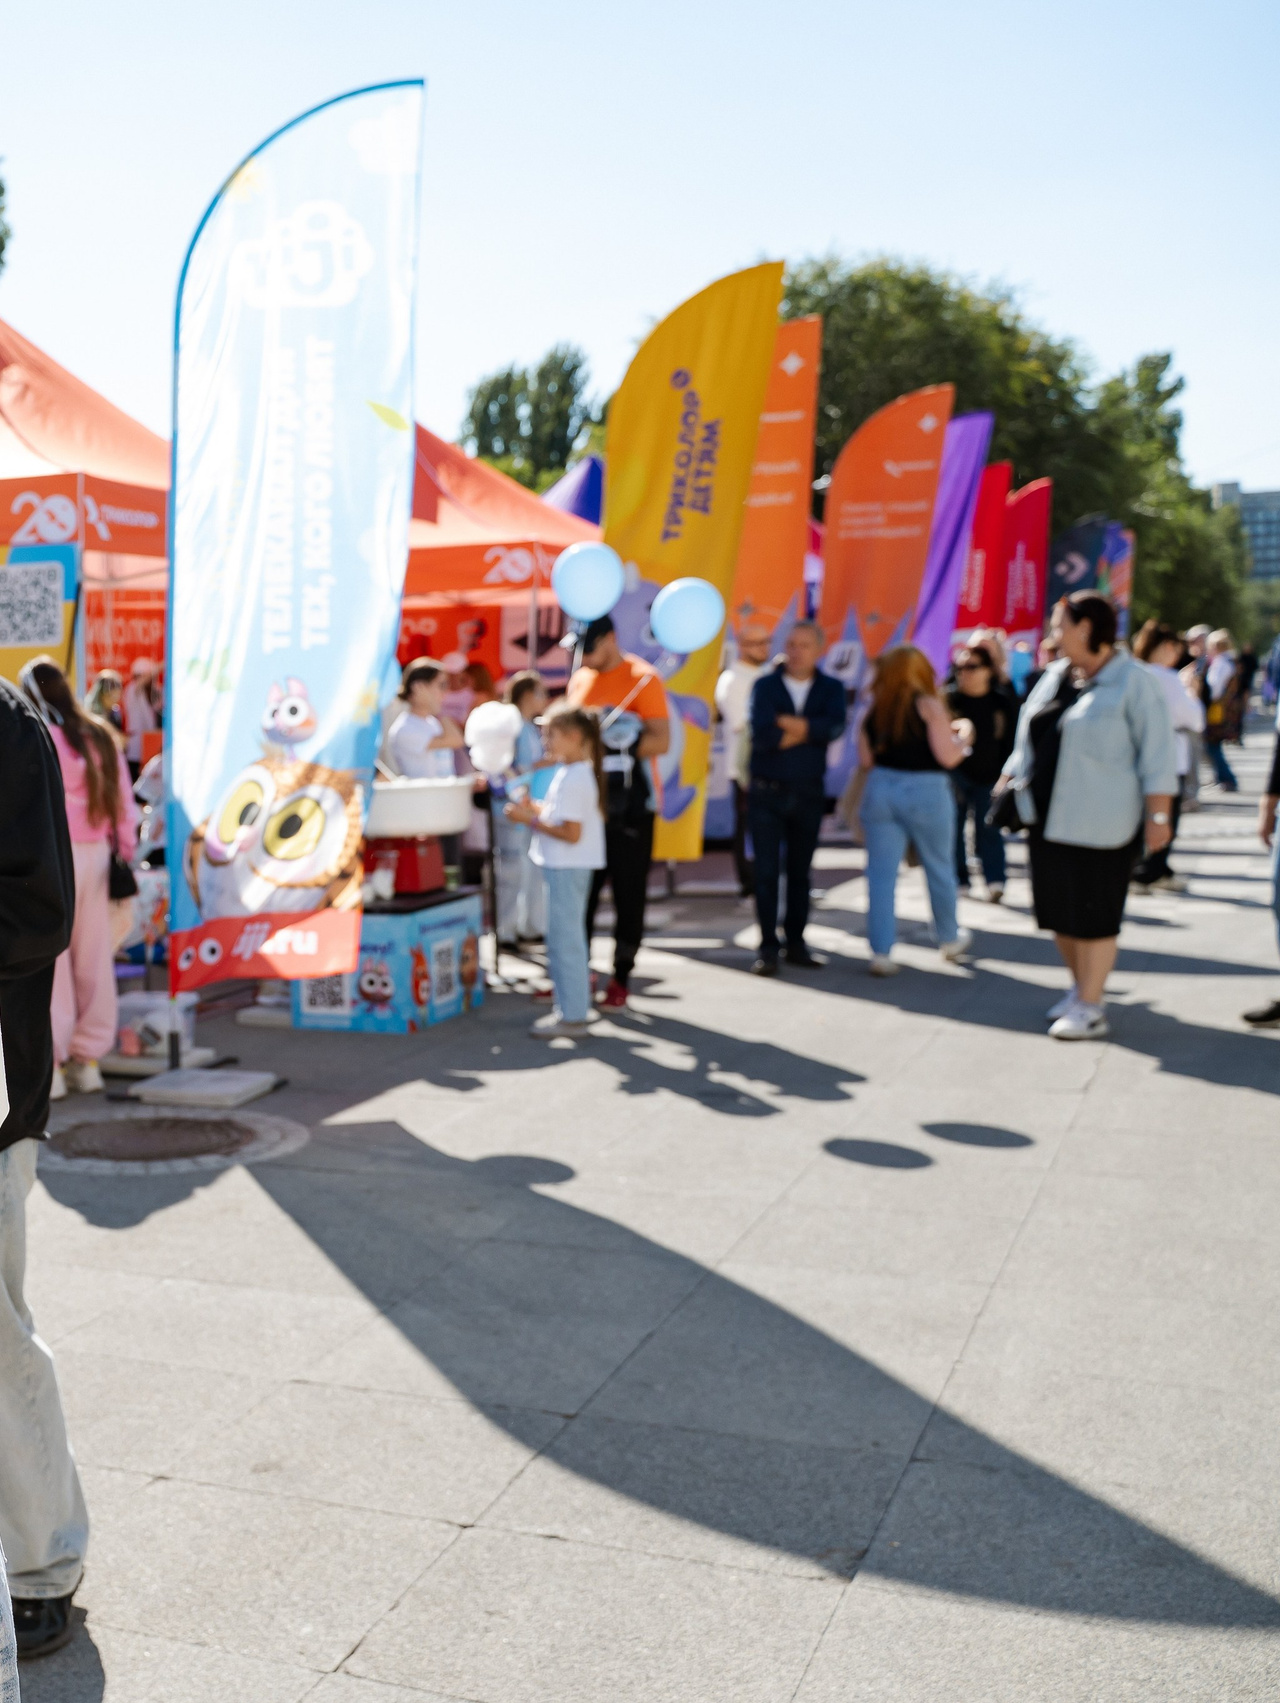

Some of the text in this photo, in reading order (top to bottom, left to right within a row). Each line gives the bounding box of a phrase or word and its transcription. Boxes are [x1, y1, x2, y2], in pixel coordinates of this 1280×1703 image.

[660, 389, 701, 544] ТРИКОЛОР
[10, 490, 77, 544] 20
[302, 472, 334, 571] КОГО
[483, 545, 535, 584] 20
[301, 574, 337, 650] ТЕХ,
